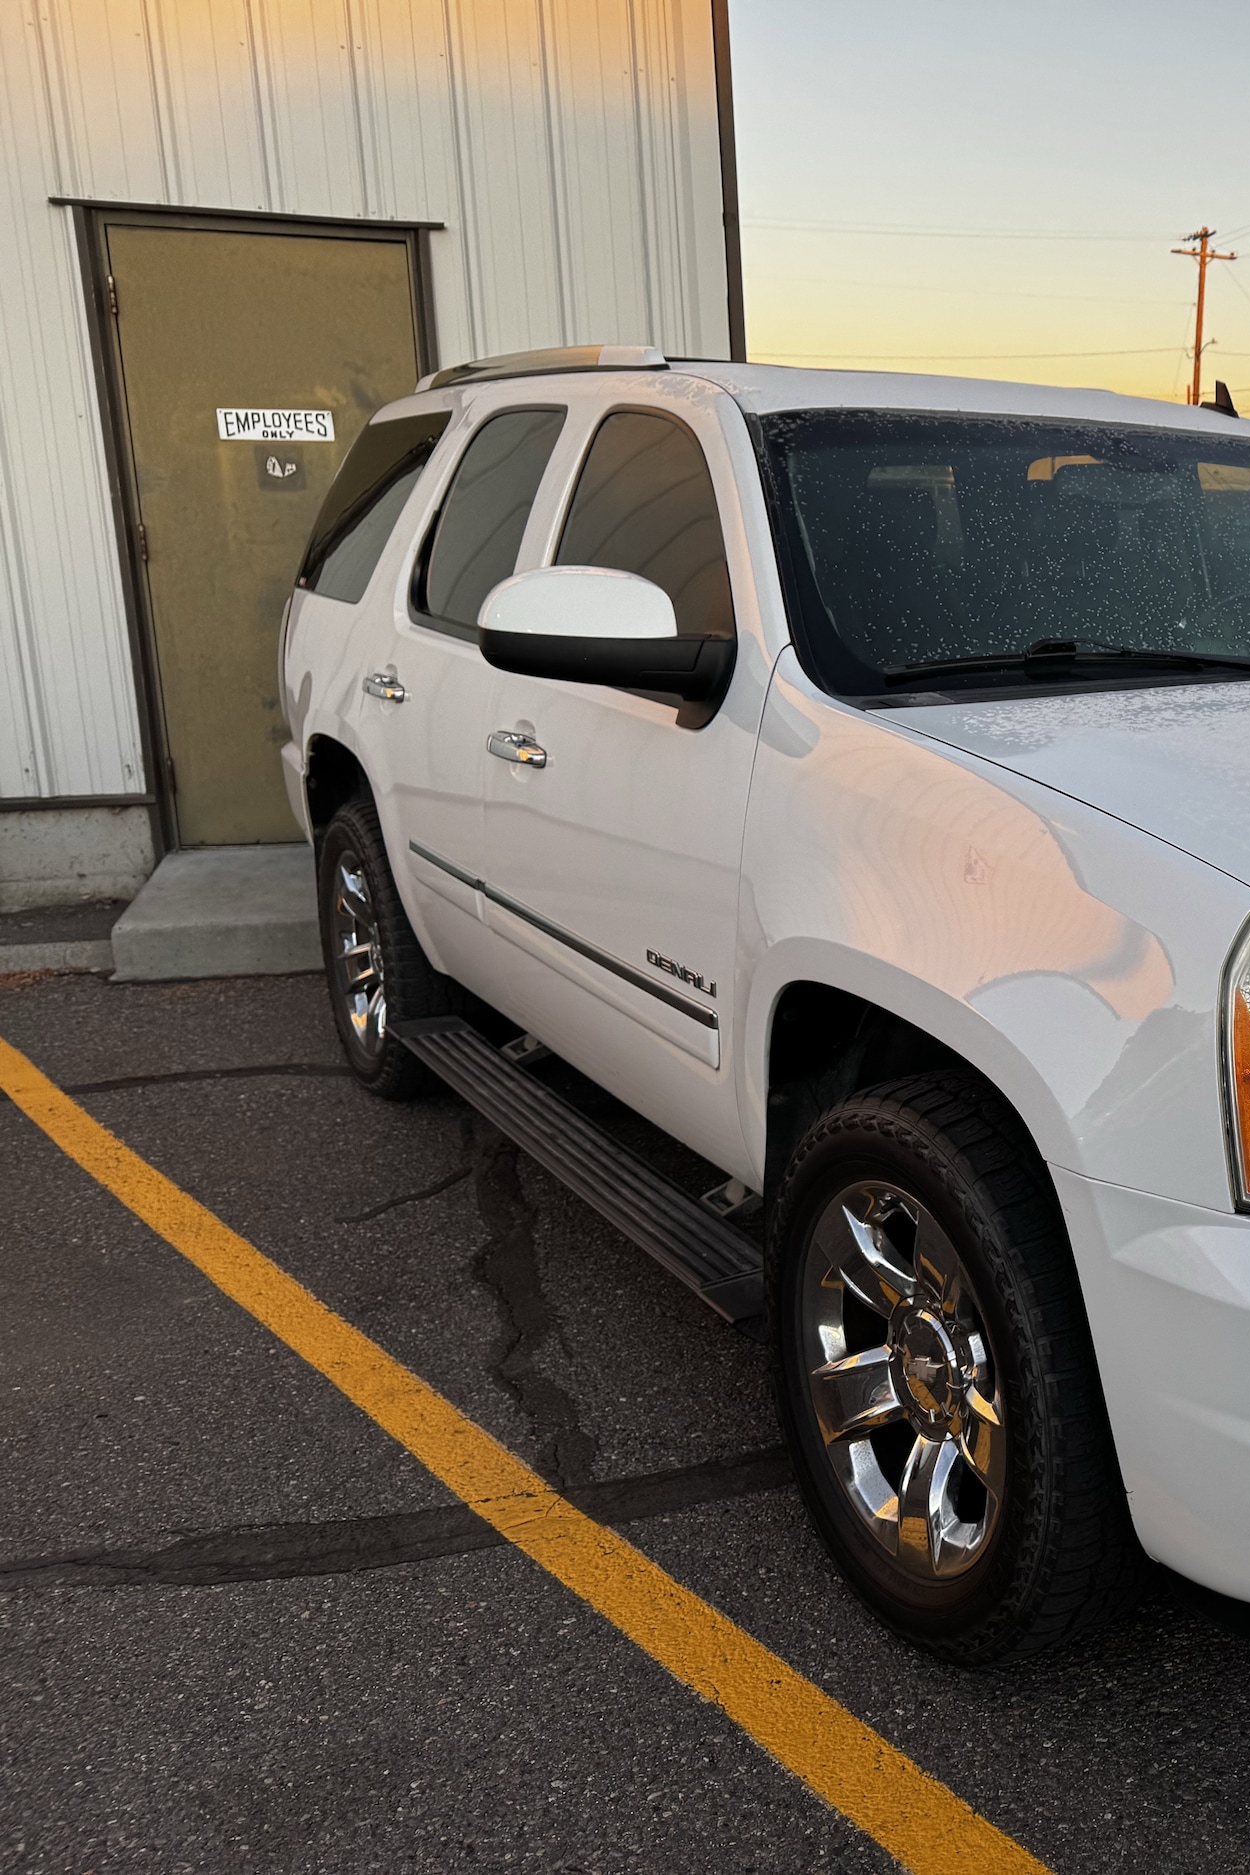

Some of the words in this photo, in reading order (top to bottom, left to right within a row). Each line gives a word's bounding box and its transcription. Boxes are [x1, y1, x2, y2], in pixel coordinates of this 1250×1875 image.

[224, 411, 328, 438] EMPLOYEES
[262, 430, 295, 439] ONLY
[646, 947, 717, 998] DENALI
